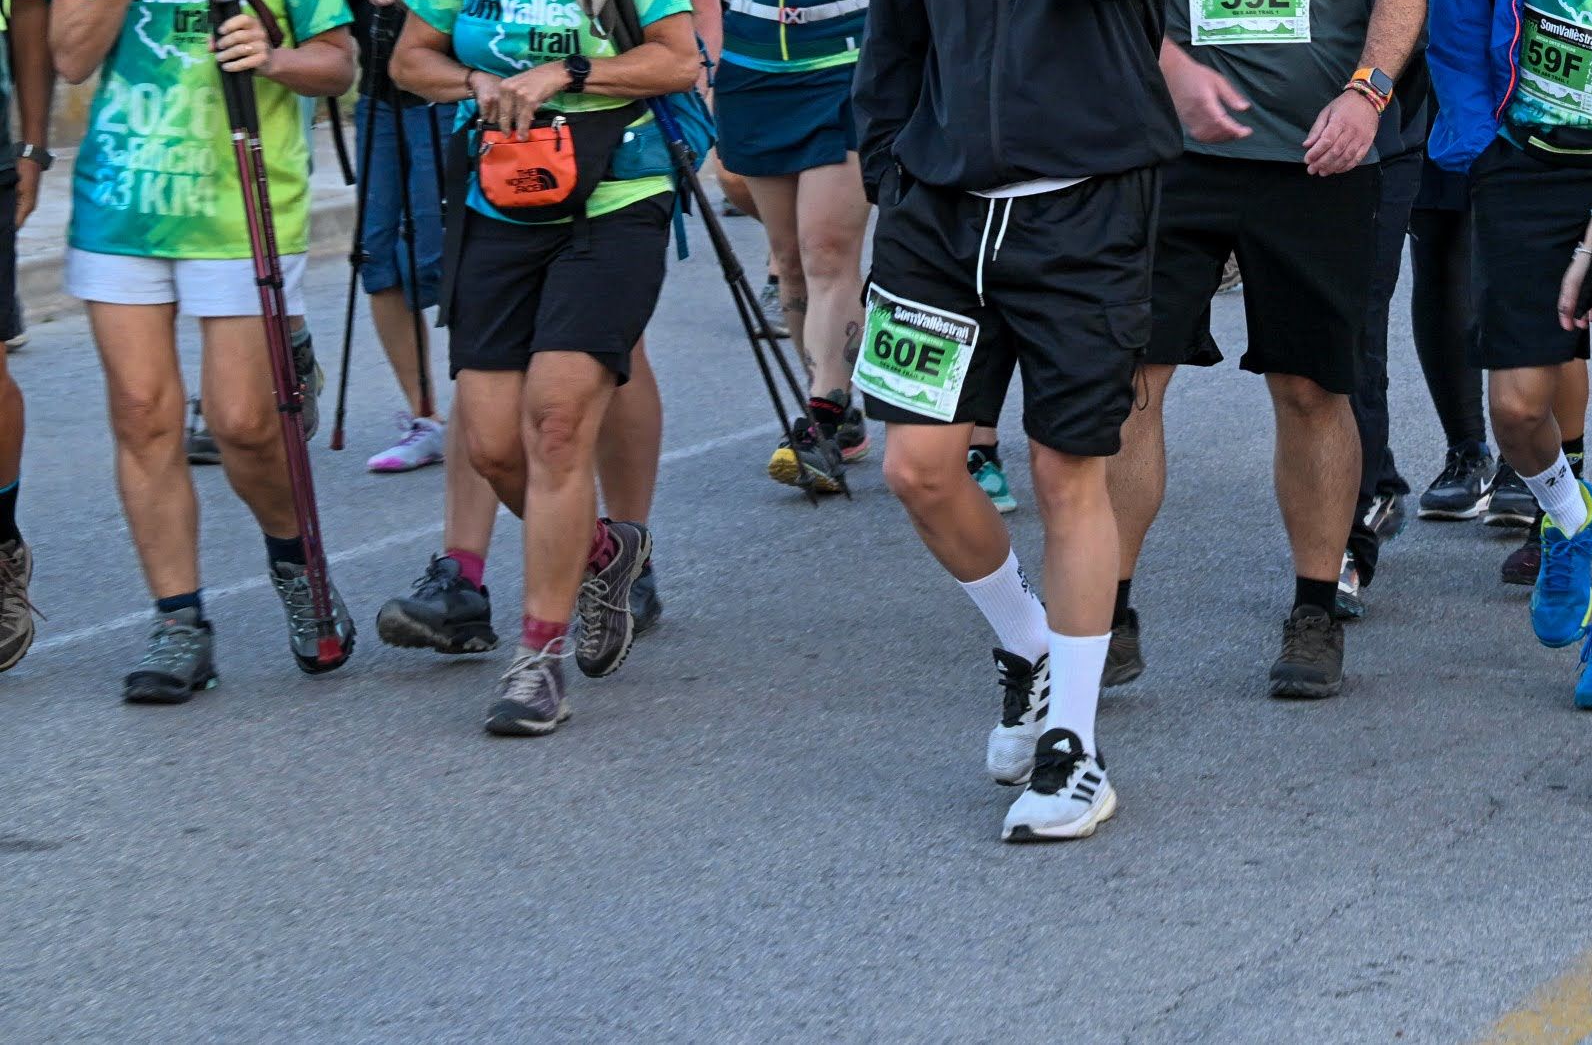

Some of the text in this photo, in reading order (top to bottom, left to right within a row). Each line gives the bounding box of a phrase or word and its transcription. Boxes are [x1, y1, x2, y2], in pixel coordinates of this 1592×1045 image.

[529, 27, 580, 55] trail
[1527, 39, 1583, 79] 59F
[874, 330, 946, 377] 60E
